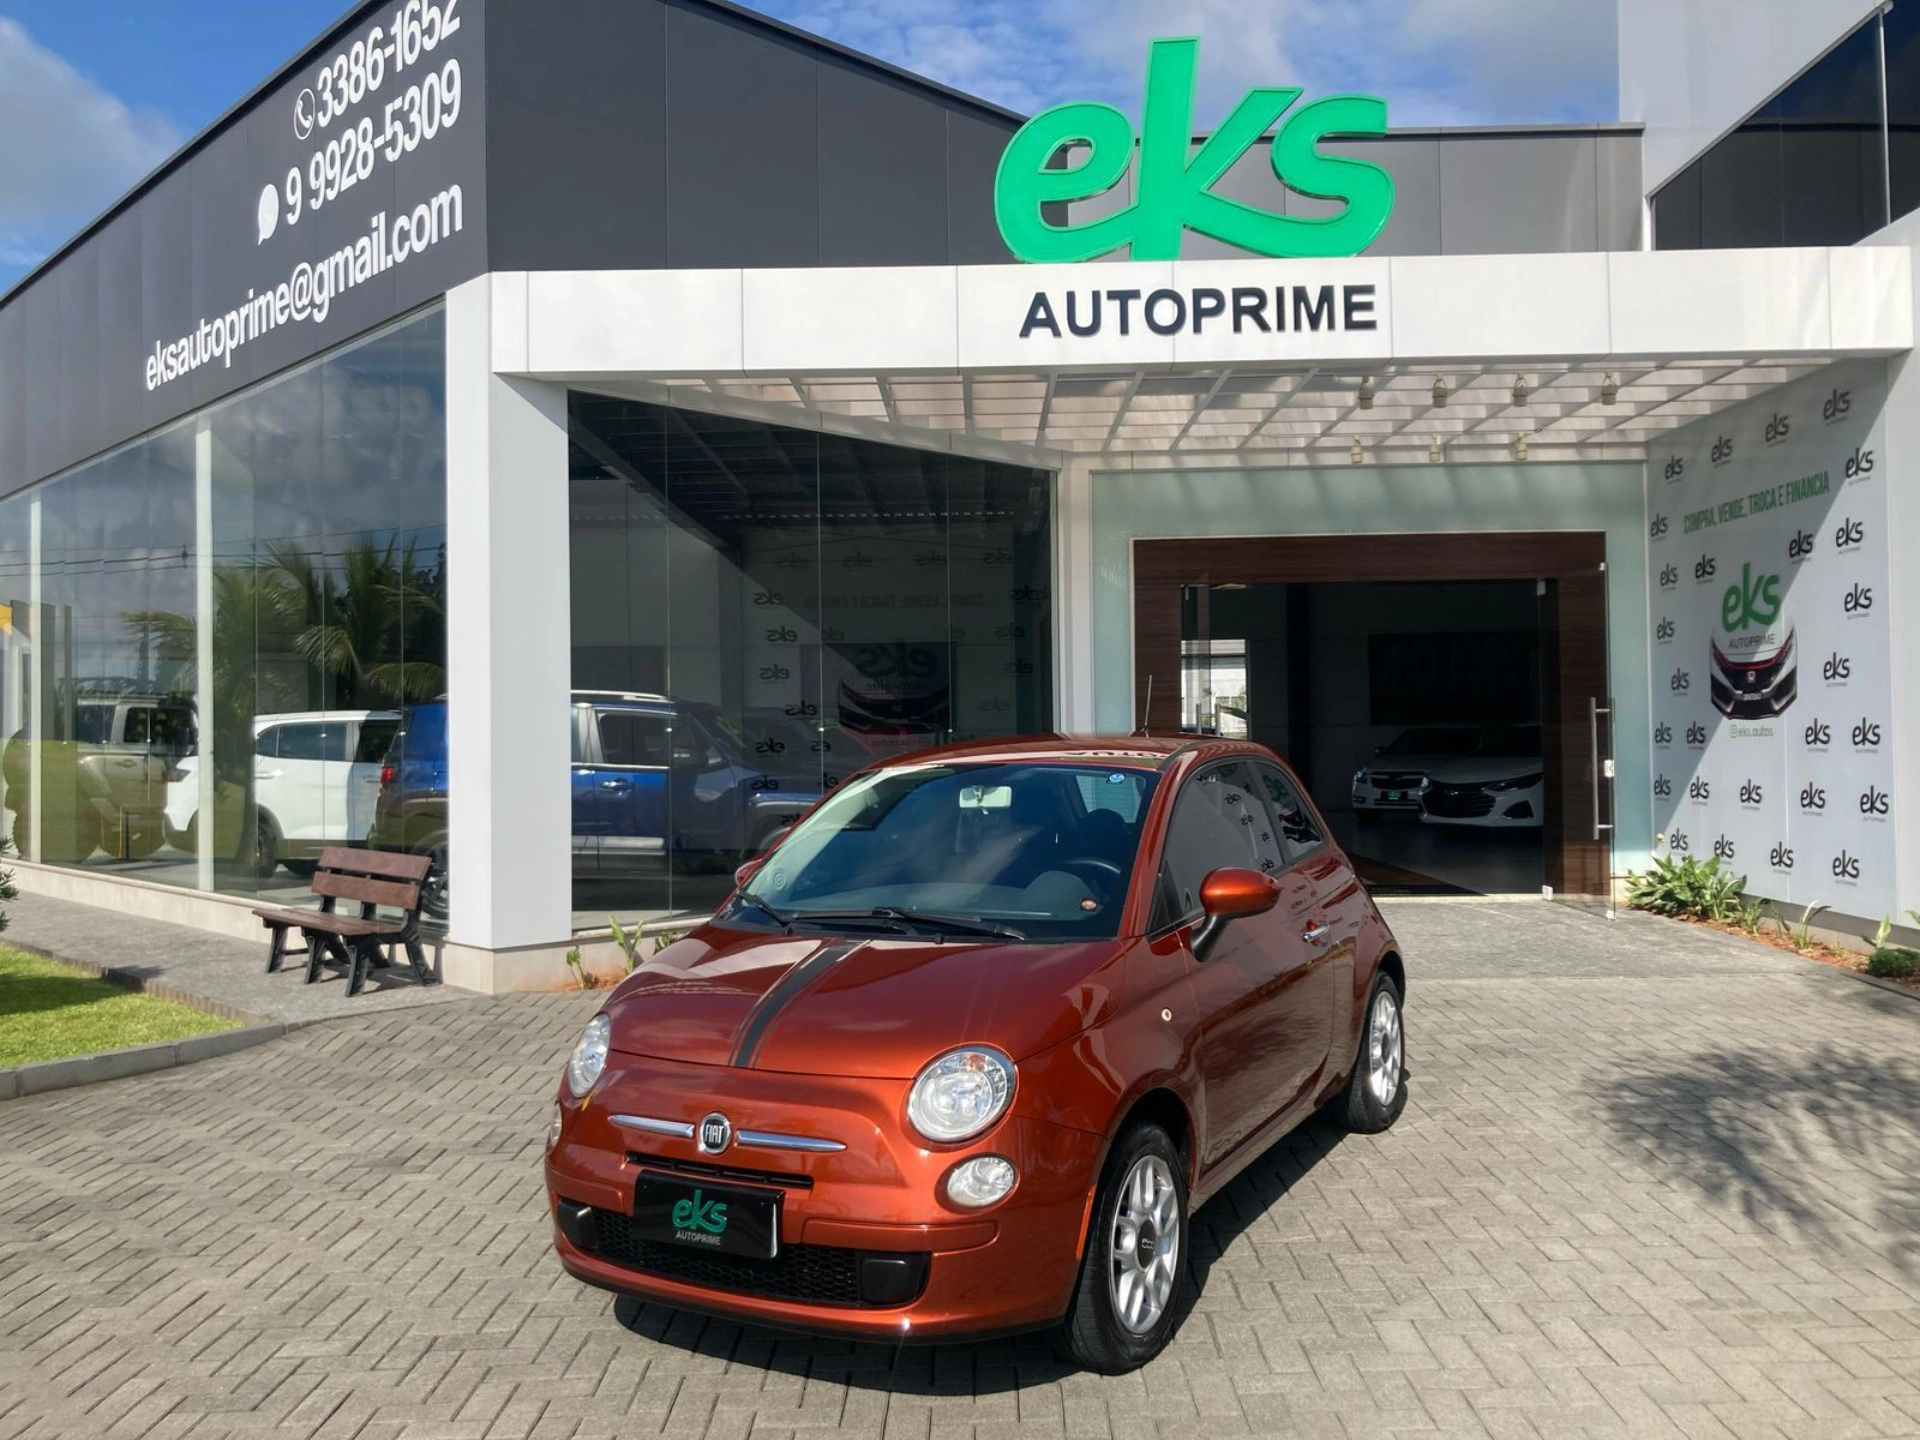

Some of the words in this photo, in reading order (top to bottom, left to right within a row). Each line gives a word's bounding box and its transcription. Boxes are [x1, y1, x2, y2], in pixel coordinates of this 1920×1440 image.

[317, 0, 460, 128] 3386-1652
[286, 166, 302, 225] 9
[310, 58, 462, 210] 9928-5309
[994, 36, 1396, 264] eks
[146, 184, 463, 391] eksautoprime@gmail.com
[1019, 284, 1378, 339] AUTOPRIME
[1823, 389, 1850, 420] eks
[1765, 413, 1789, 442] eks
[1711, 436, 1733, 462] eks
[1846, 447, 1874, 478] eks
[1665, 456, 1683, 479] eks
[1747, 487, 1777, 515] TROCA
[1778, 484, 1785, 506] E
[1786, 470, 1830, 504] FINANCIA
[1650, 513, 1668, 538] eks
[1836, 517, 1863, 547] eks
[1789, 529, 1813, 558] eks
[1660, 563, 1678, 587] eks
[1695, 554, 1715, 580] eks
[1722, 562, 1783, 633] eks
[1844, 582, 1872, 612] eks
[1657, 617, 1675, 640] eks
[1728, 633, 1776, 649] AUTOPRIME
[1671, 667, 1690, 690] eks
[1823, 652, 1850, 680] eks
[1655, 721, 1672, 744] eks
[1686, 721, 1706, 745] eks
[1805, 718, 1831, 745] eks
[1852, 717, 1881, 746] eks
[1654, 773, 1671, 796] eks
[1690, 776, 1709, 799] eks
[1740, 778, 1762, 804] eks
[1800, 781, 1826, 809] eks
[1860, 785, 1889, 814] eks
[1670, 827, 1688, 851] eks
[1714, 833, 1735, 859] eks
[1770, 841, 1794, 868] eks
[1832, 849, 1860, 879] eks
[705, 1124, 724, 1143] FIAT
[671, 1189, 728, 1233] eks
[676, 1230, 721, 1245] AUTOPRIME
